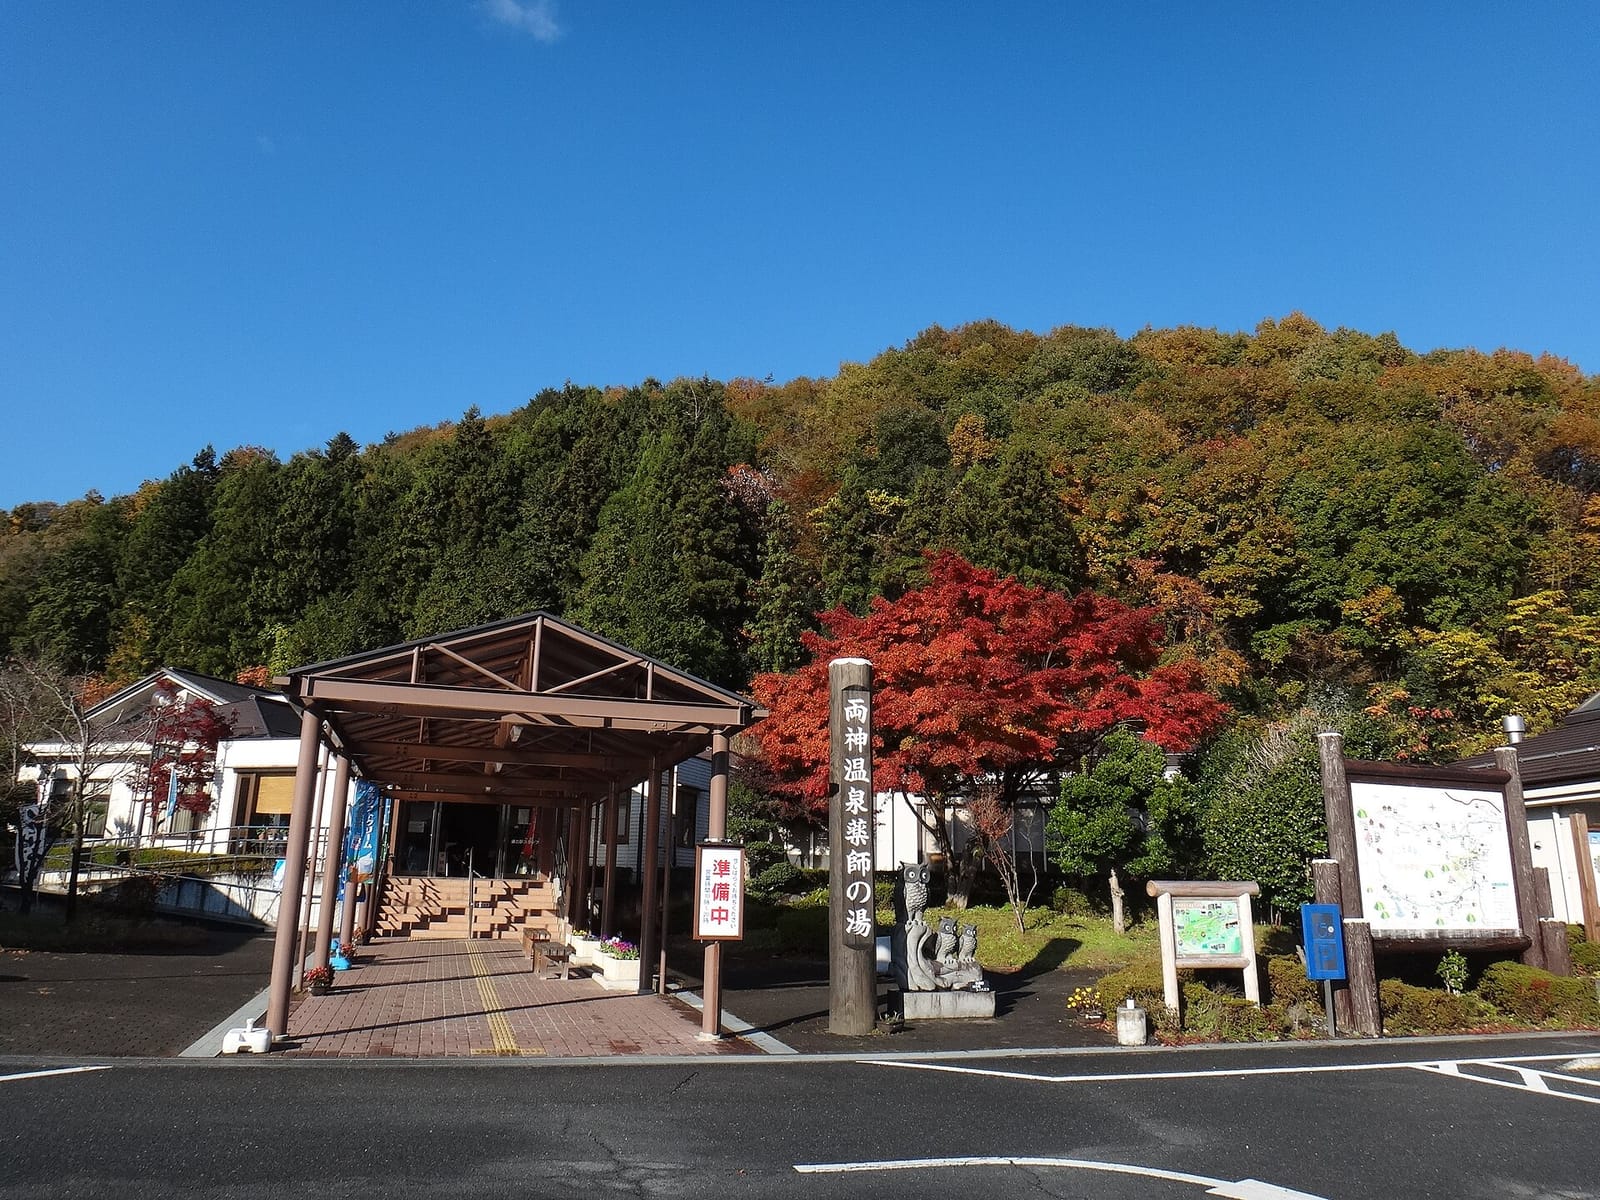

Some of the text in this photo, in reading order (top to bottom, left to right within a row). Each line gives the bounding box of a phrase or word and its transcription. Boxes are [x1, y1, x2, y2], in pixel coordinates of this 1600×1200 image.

[711, 859, 730, 925] 準備中
[843, 699, 872, 937] 両神温泉薬師の湯
